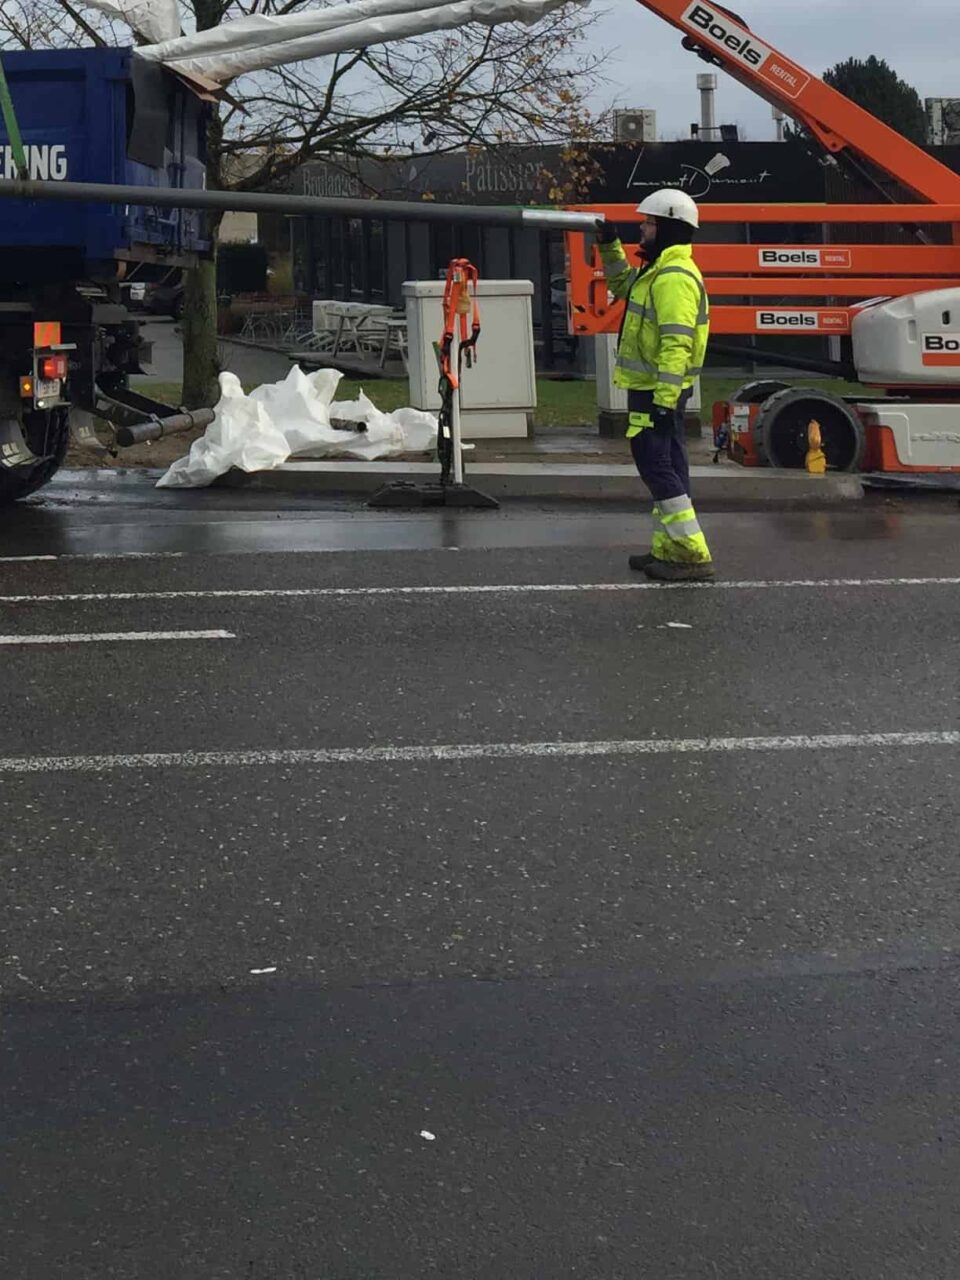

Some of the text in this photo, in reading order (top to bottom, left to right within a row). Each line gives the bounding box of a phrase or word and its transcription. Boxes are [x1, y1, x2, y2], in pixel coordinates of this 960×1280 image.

[687, 5, 797, 88] Boels RENTAL
[762, 250, 817, 263] Boels
[760, 313, 815, 325] Boels
[925, 336, 959, 351] Bo
